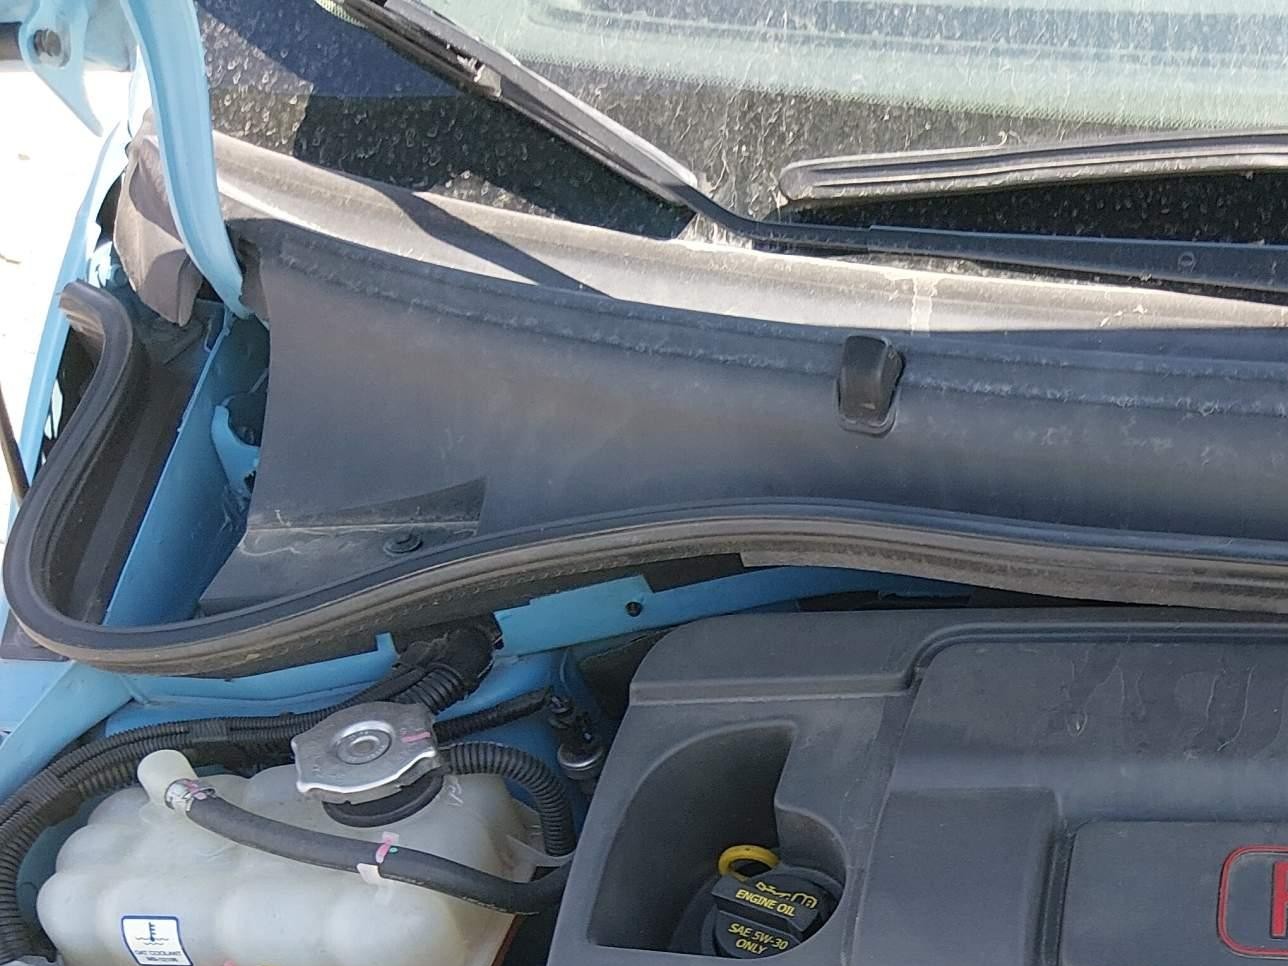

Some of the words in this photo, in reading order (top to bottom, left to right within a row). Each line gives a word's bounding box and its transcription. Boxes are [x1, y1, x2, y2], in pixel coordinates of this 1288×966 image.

[735, 889, 778, 910] ENGINE
[776, 903, 797, 917] OIL
[728, 923, 753, 938] SAE
[752, 931, 789, 950] 5W-30
[735, 938, 768, 955] ONLY
